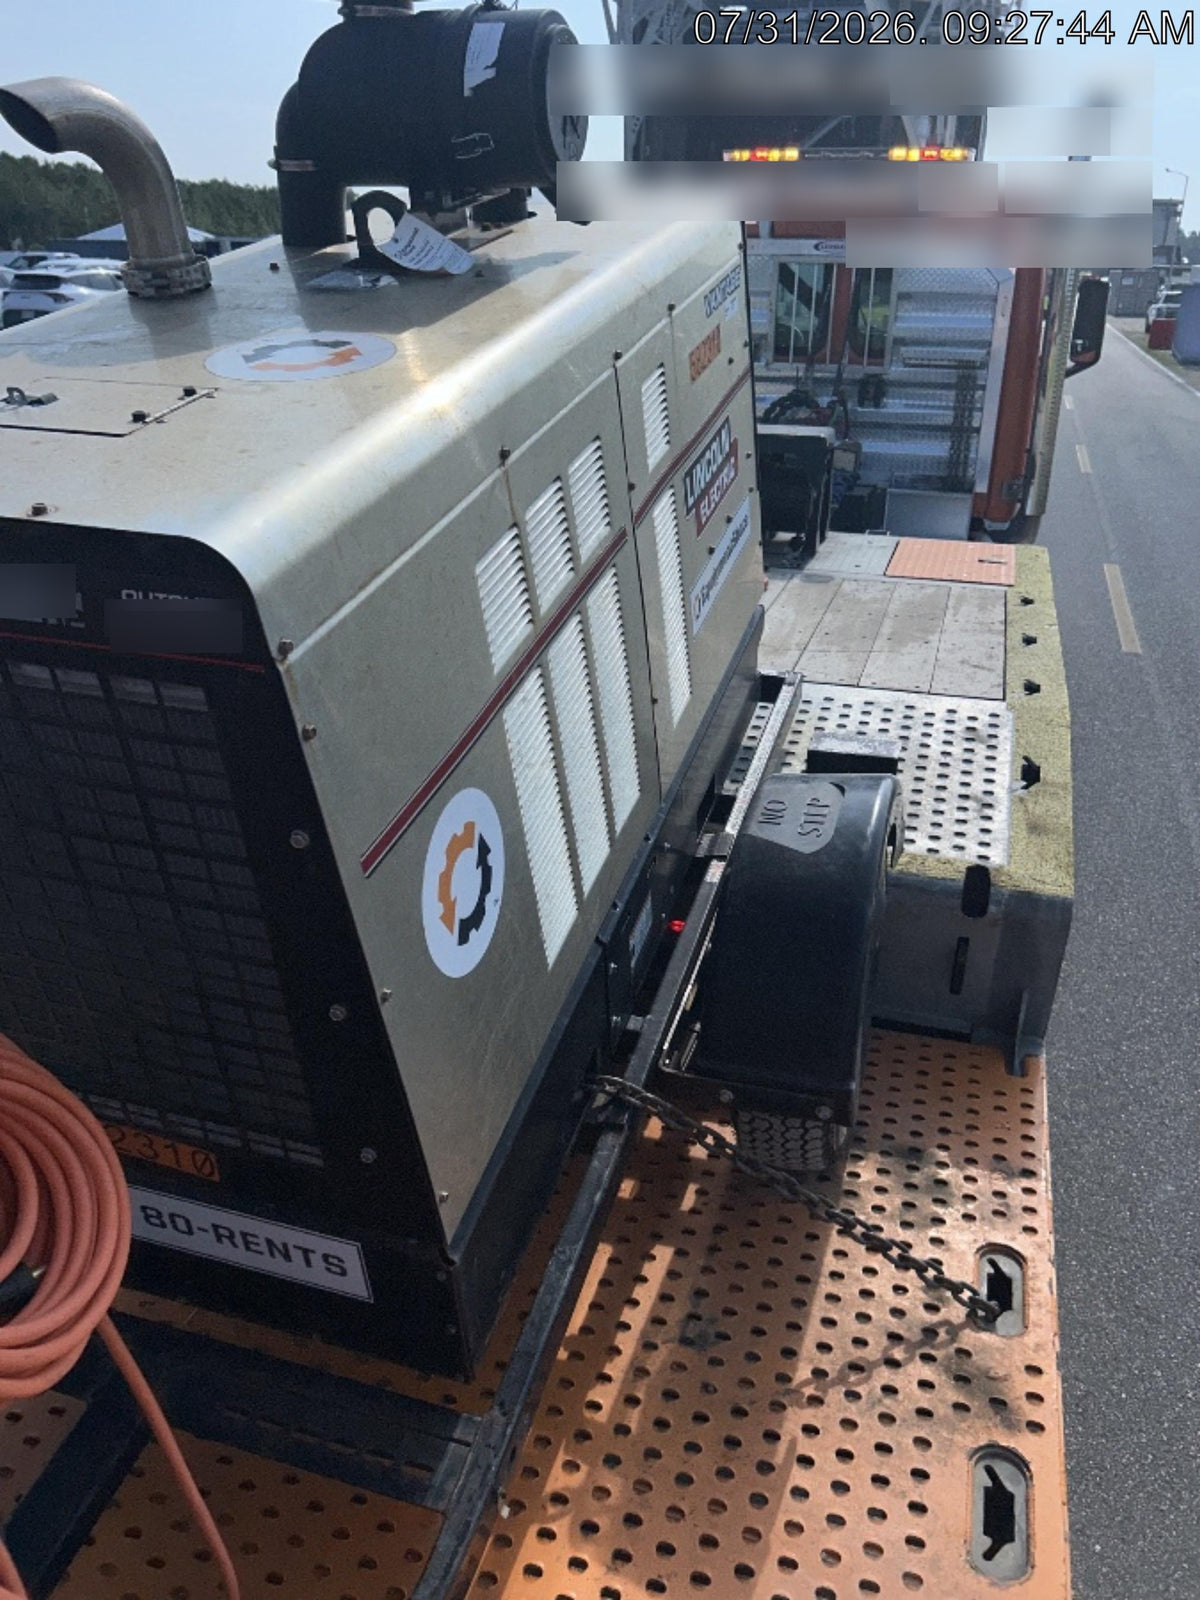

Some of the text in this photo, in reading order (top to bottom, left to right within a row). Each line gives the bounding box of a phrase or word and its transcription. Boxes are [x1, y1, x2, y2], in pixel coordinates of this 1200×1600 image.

[685, 421, 729, 509] LINCOLN
[700, 456, 735, 525] ELECTRIC
[758, 799, 788, 826] NO
[140, 1204, 348, 1278] 80-RENTS
